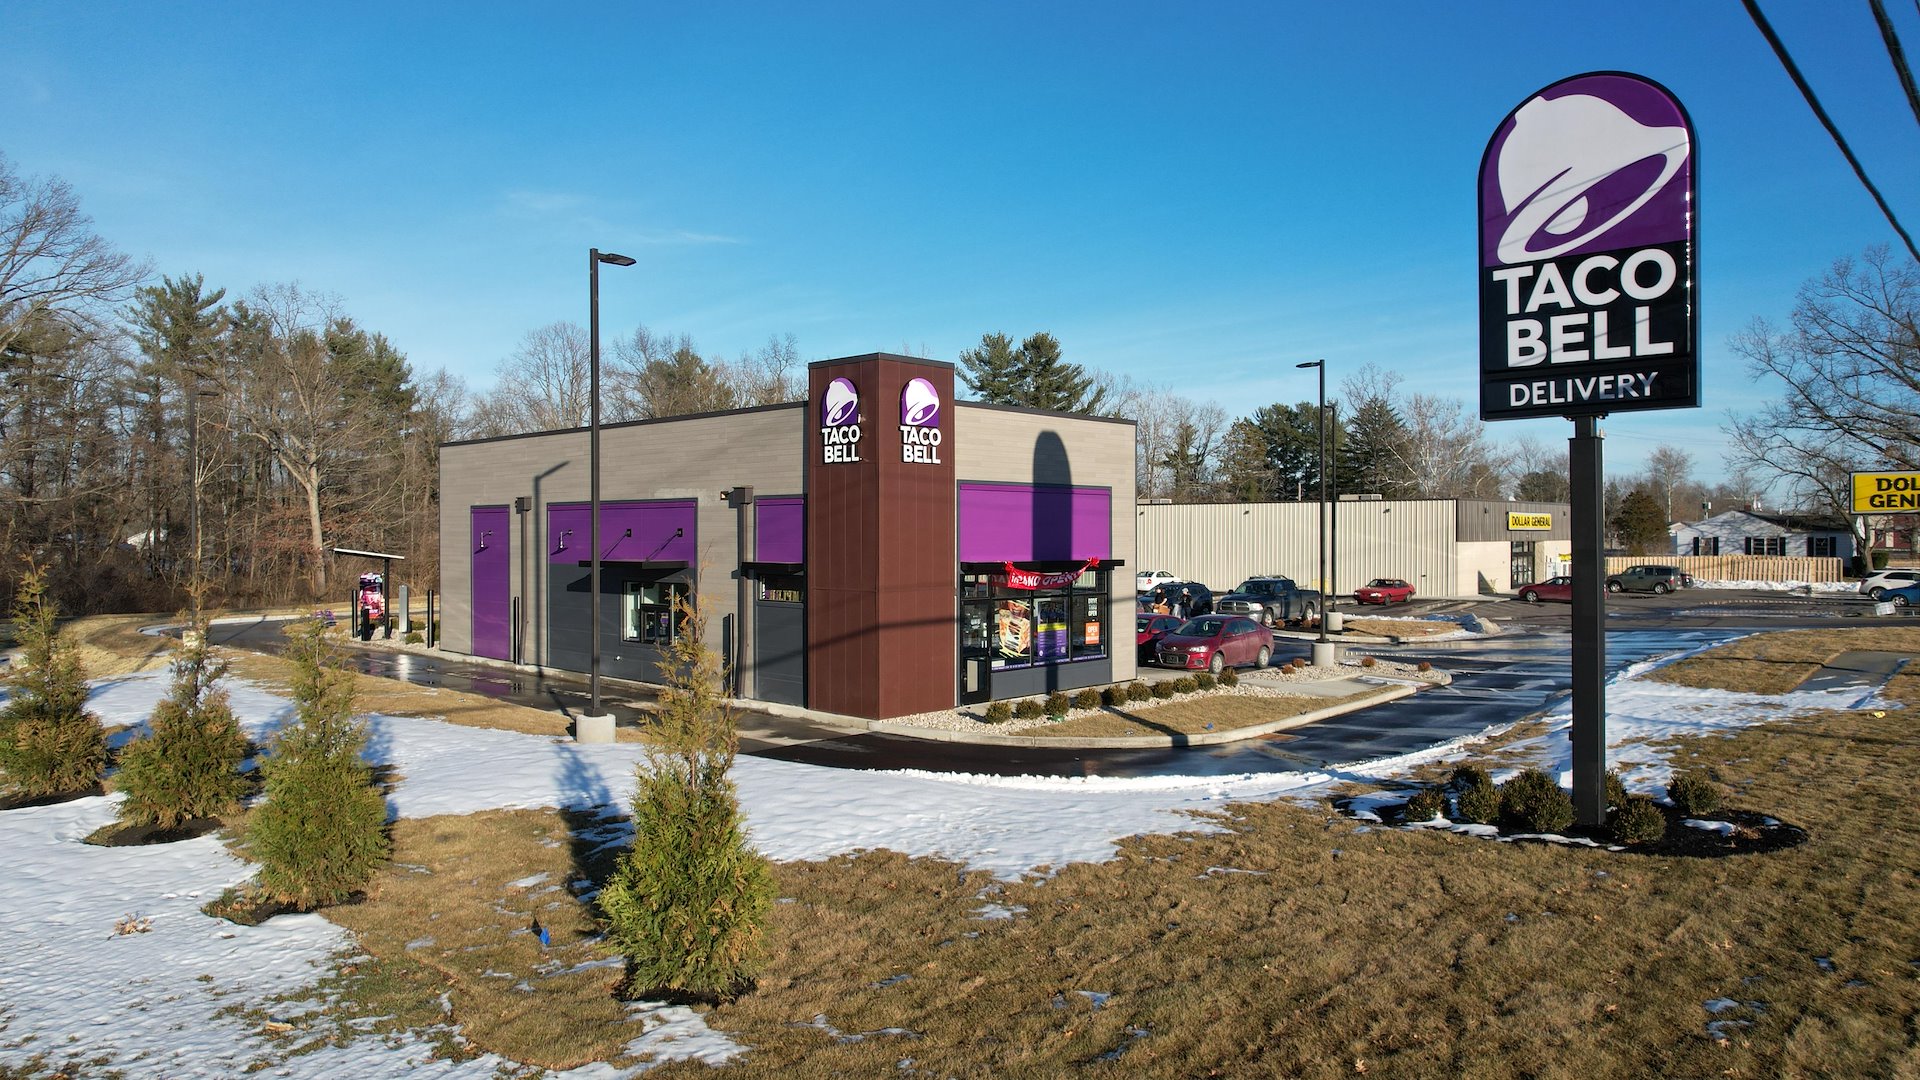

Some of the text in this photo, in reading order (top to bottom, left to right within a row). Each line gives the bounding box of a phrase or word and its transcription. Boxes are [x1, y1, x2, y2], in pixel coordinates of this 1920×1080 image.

[1492, 248, 1677, 315] TACO
[1506, 305, 1674, 368] BELL
[1509, 371, 1659, 407] DELIVERY
[822, 425, 860, 445] TACO
[900, 425, 942, 446] TACO
[824, 444, 860, 464] BELL
[903, 444, 941, 464] BELL
[1869, 494, 1920, 508] GEN
[1512, 515, 1551, 527] DOLLAR GENERAL
